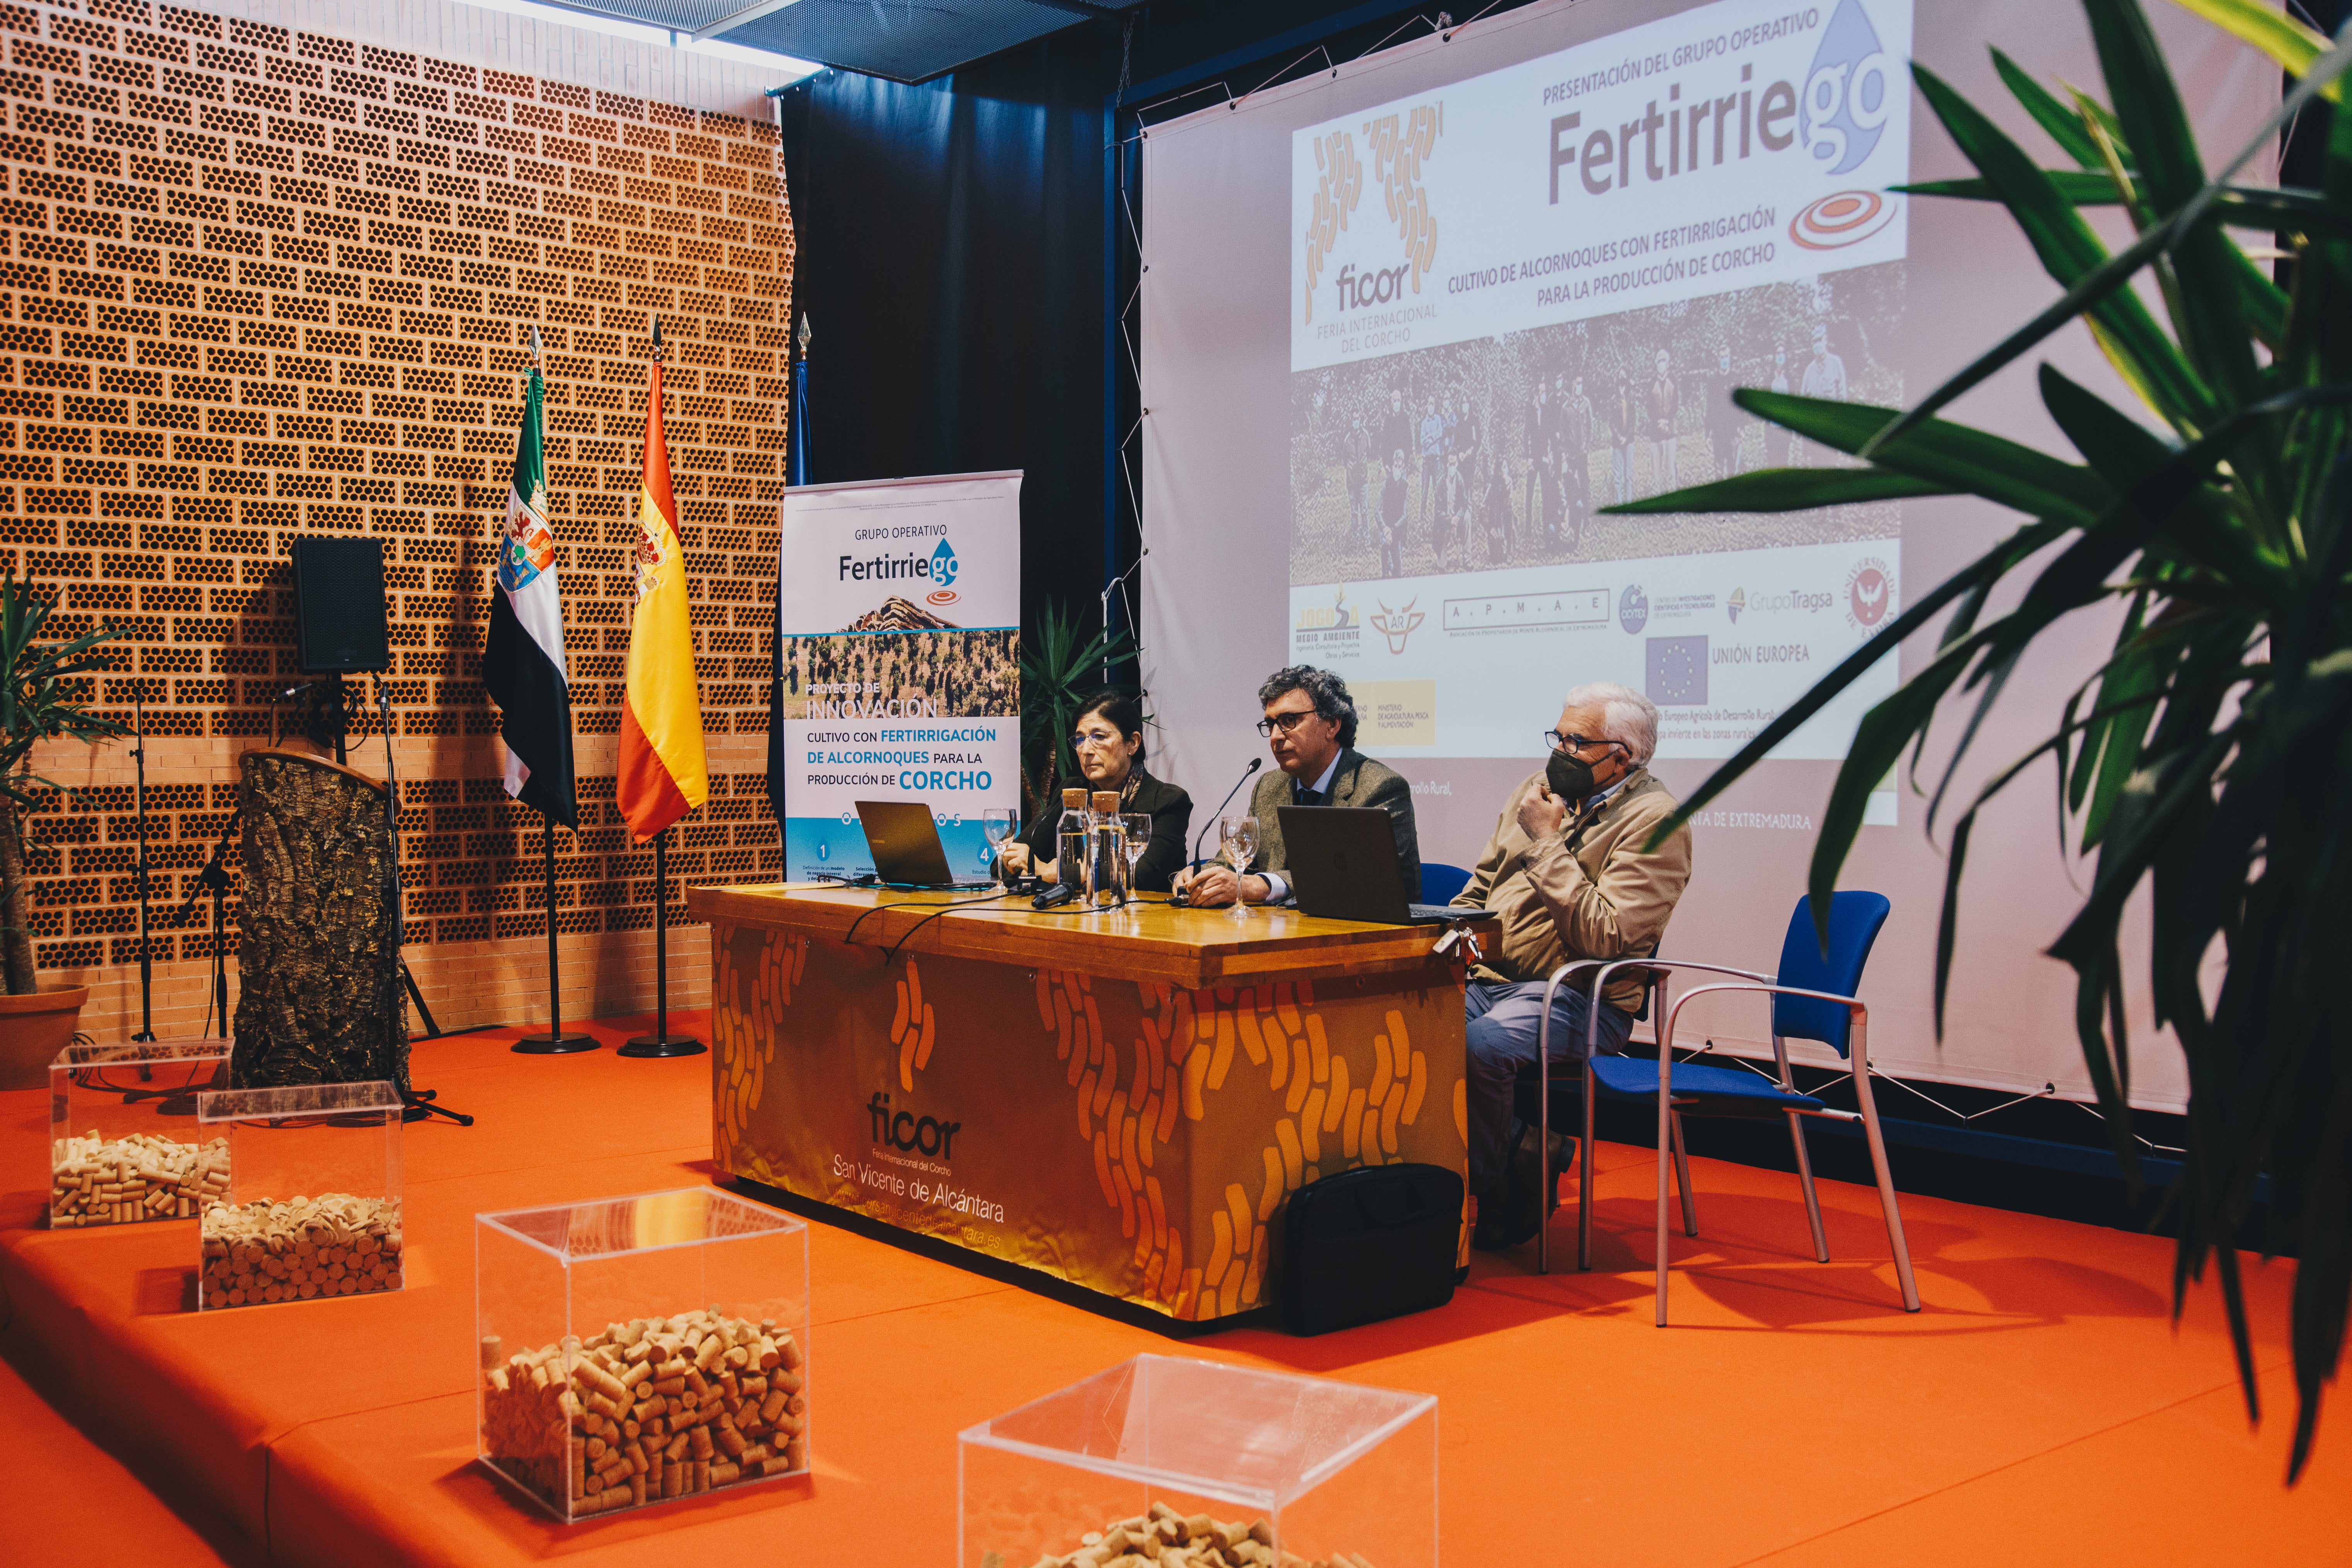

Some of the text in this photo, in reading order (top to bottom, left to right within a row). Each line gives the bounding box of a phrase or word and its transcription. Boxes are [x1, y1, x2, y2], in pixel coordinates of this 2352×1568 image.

[1543, 8, 1819, 106] PRESENTACIÓN DEL GRUPO OPERATIVO
[1549, 53, 1888, 206] Fertirriego
[1448, 205, 1776, 294] CULTIVO DE ALCORNOQUES CON FERTIRRIGACIÓN
[1336, 263, 1410, 312] ficor
[1537, 242, 1776, 307] PARA LA PRODUCCIÓN DE CORCHO
[1317, 304, 1437, 339] FERIA INTERNACIONAL
[1342, 327, 1411, 353] DEL CORCHO
[855, 524, 947, 540] GRUPO OPERATIVO
[839, 552, 958, 585] Fertirriego
[1390, 616, 1404, 629] AR
[1296, 631, 1360, 643] MEDIO AMBIENTE
[1713, 643, 1810, 664] UNIÓN EUROPEA
[805, 683, 880, 695] PROYECTO DE
[806, 693, 937, 720] INNOVACIÓN
[807, 725, 996, 742] CULTIVO CON FERTIRRIGACIÓN
[807, 751, 982, 766] DE ALCORNOQUES PARA LA
[808, 770, 992, 790] PRODUCCIÓN DE CORCHO
[1714, 811, 1726, 827] DE
[1729, 812, 1812, 830] EXTREMADURA
[820, 844, 825, 858] 1
[980, 848, 989, 861] 4
[866, 1091, 961, 1160] ficor
[873, 1148, 951, 1176] Feria Internacional del Corcho
[834, 1154, 1004, 1223] San Vicente de Alcántara
